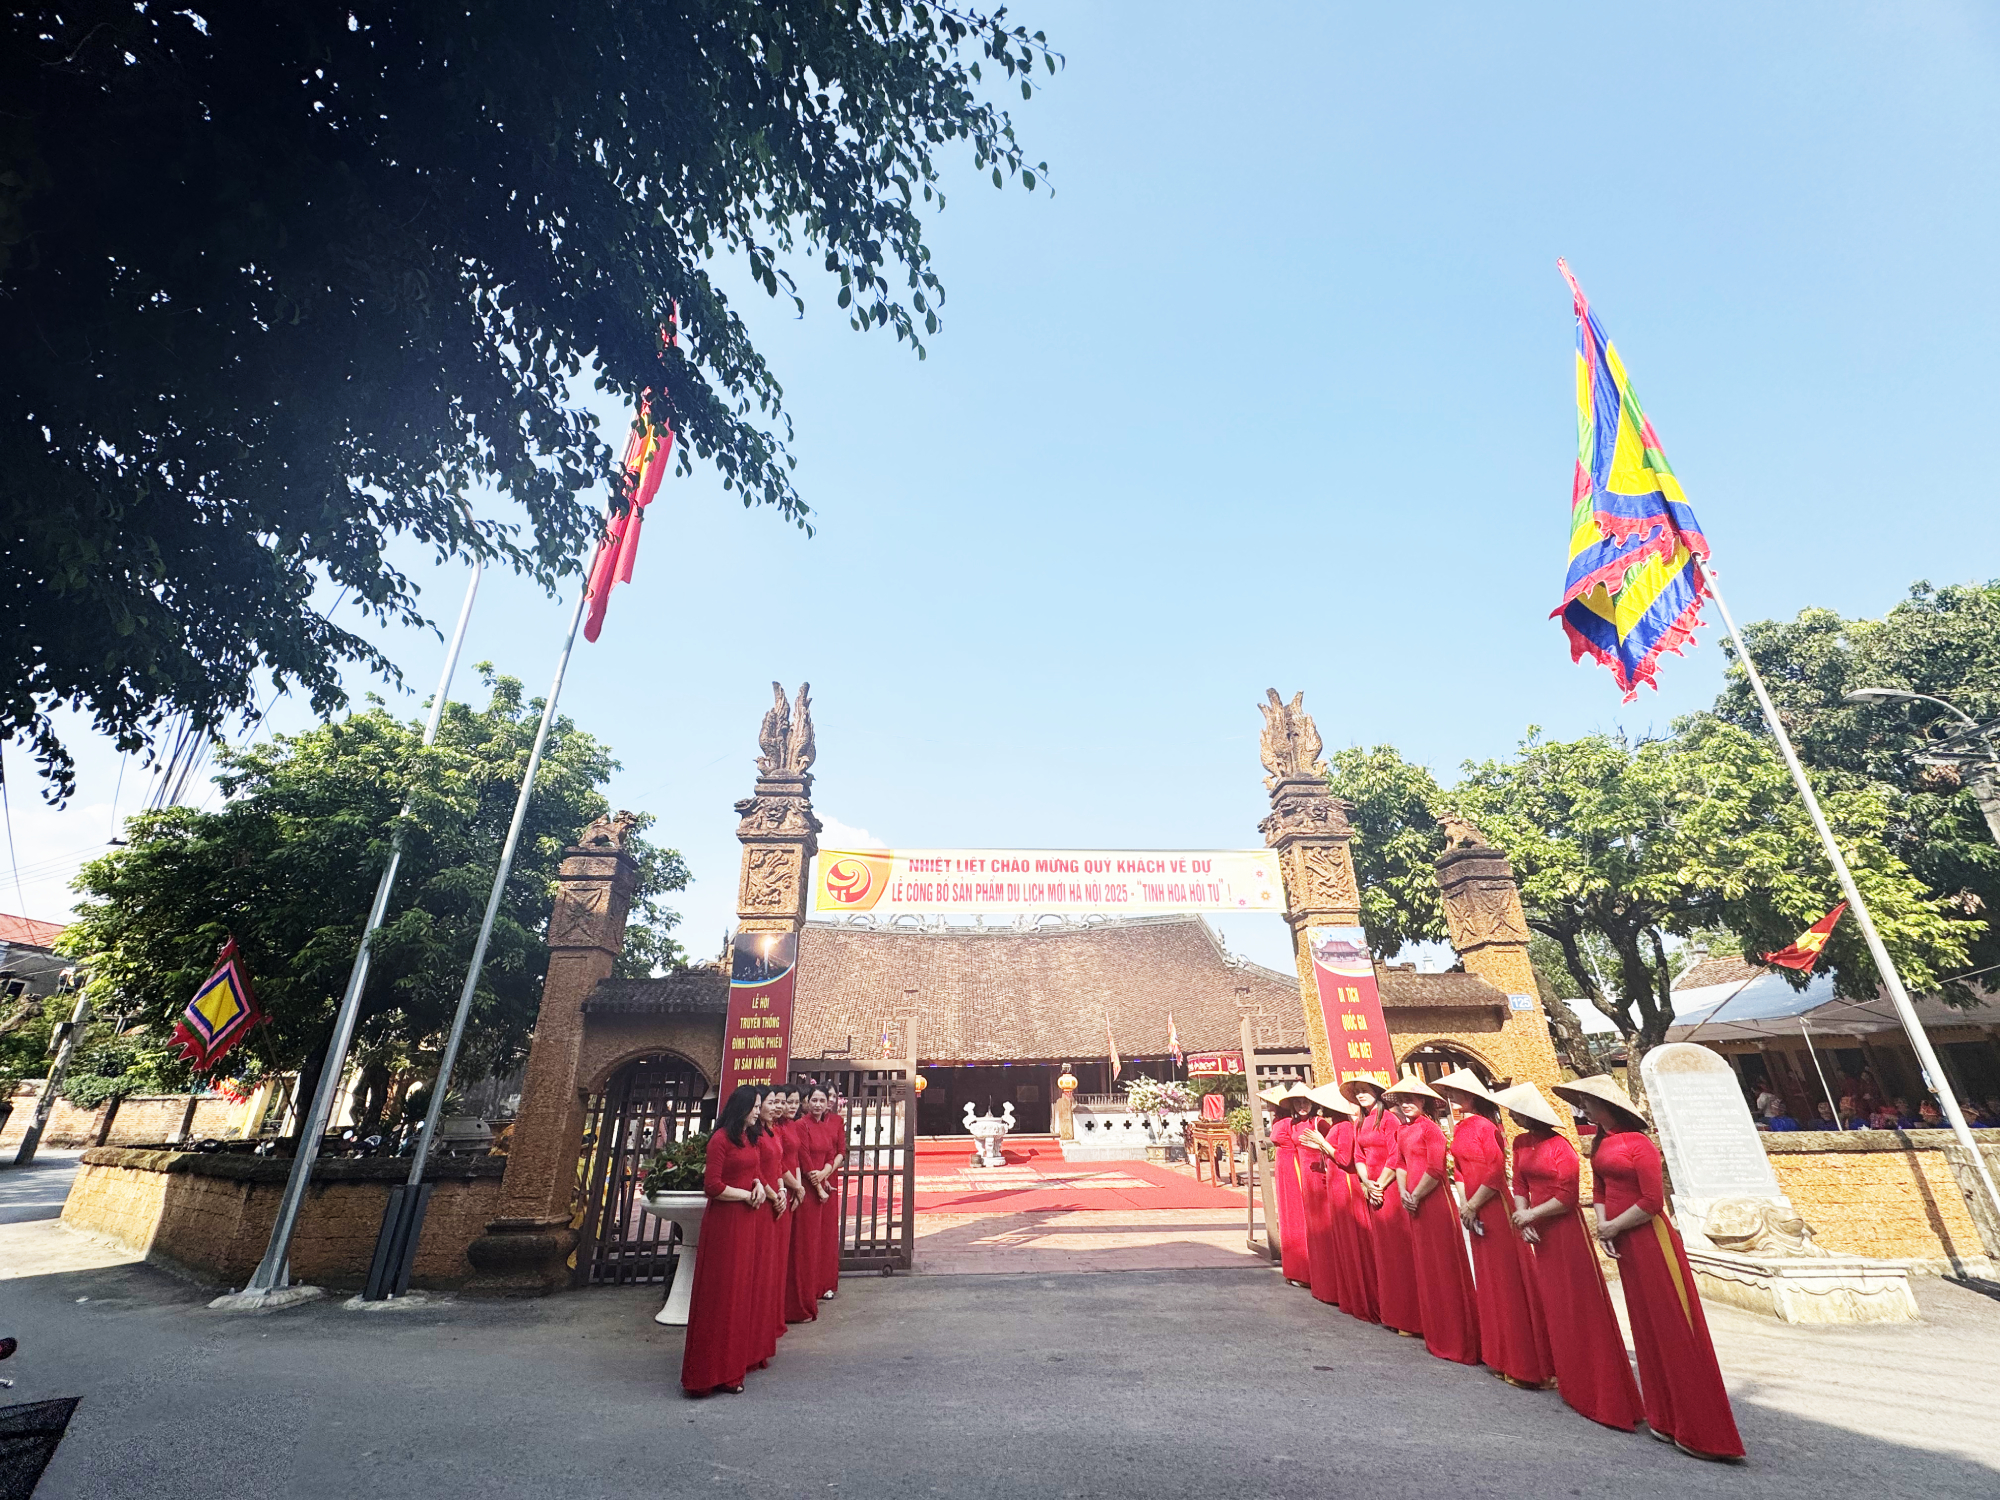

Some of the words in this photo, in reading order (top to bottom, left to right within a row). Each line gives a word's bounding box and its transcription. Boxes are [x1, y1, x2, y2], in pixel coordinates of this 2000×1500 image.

[909, 857, 951, 875] NHIỆT
[956, 857, 986, 875] LIỆT
[991, 857, 1030, 873] CHÀO
[1035, 857, 1079, 873] MỪNG
[1084, 857, 1111, 874] QUÝ
[1117, 857, 1165, 873] KHÁCH
[1170, 856, 1187, 873] VỀ
[1192, 859, 1212, 876] DỰ
[892, 876, 903, 902] LỄ
[906, 878, 933, 902] CÔNG
[936, 876, 950, 902] BỐ
[952, 876, 972, 902] SẢN
[975, 875, 1004, 902] PHẨM
[1007, 883, 1020, 902] DU
[1023, 883, 1045, 906] LỊCH
[1047, 879, 1066, 902] MỚI
[1069, 879, 1082, 902] HÀ
[1085, 879, 1102, 907] NỘI
[1105, 883, 1128, 902] 2025
[1167, 883, 1187, 902] HOA
[1189, 879, 1206, 906] HỘI
[751, 993, 759, 1009] LỄ
[759, 994, 770, 1011] HỘI
[1337, 987, 1345, 1002] DI
[1345, 983, 1360, 1003] TÍCH
[1513, 997, 1531, 1008] 125
[740, 1013, 761, 1029] TRUYỀN
[762, 1012, 780, 1028] THỐNG
[1341, 1009, 1357, 1032] QUỐC
[732, 1035, 746, 1050] ĐÌNH
[766, 1033, 783, 1049] PHIÊU
[733, 1058, 741, 1070] DI
[741, 1054, 753, 1070] SẢN
[753, 1055, 765, 1069] VĂN
